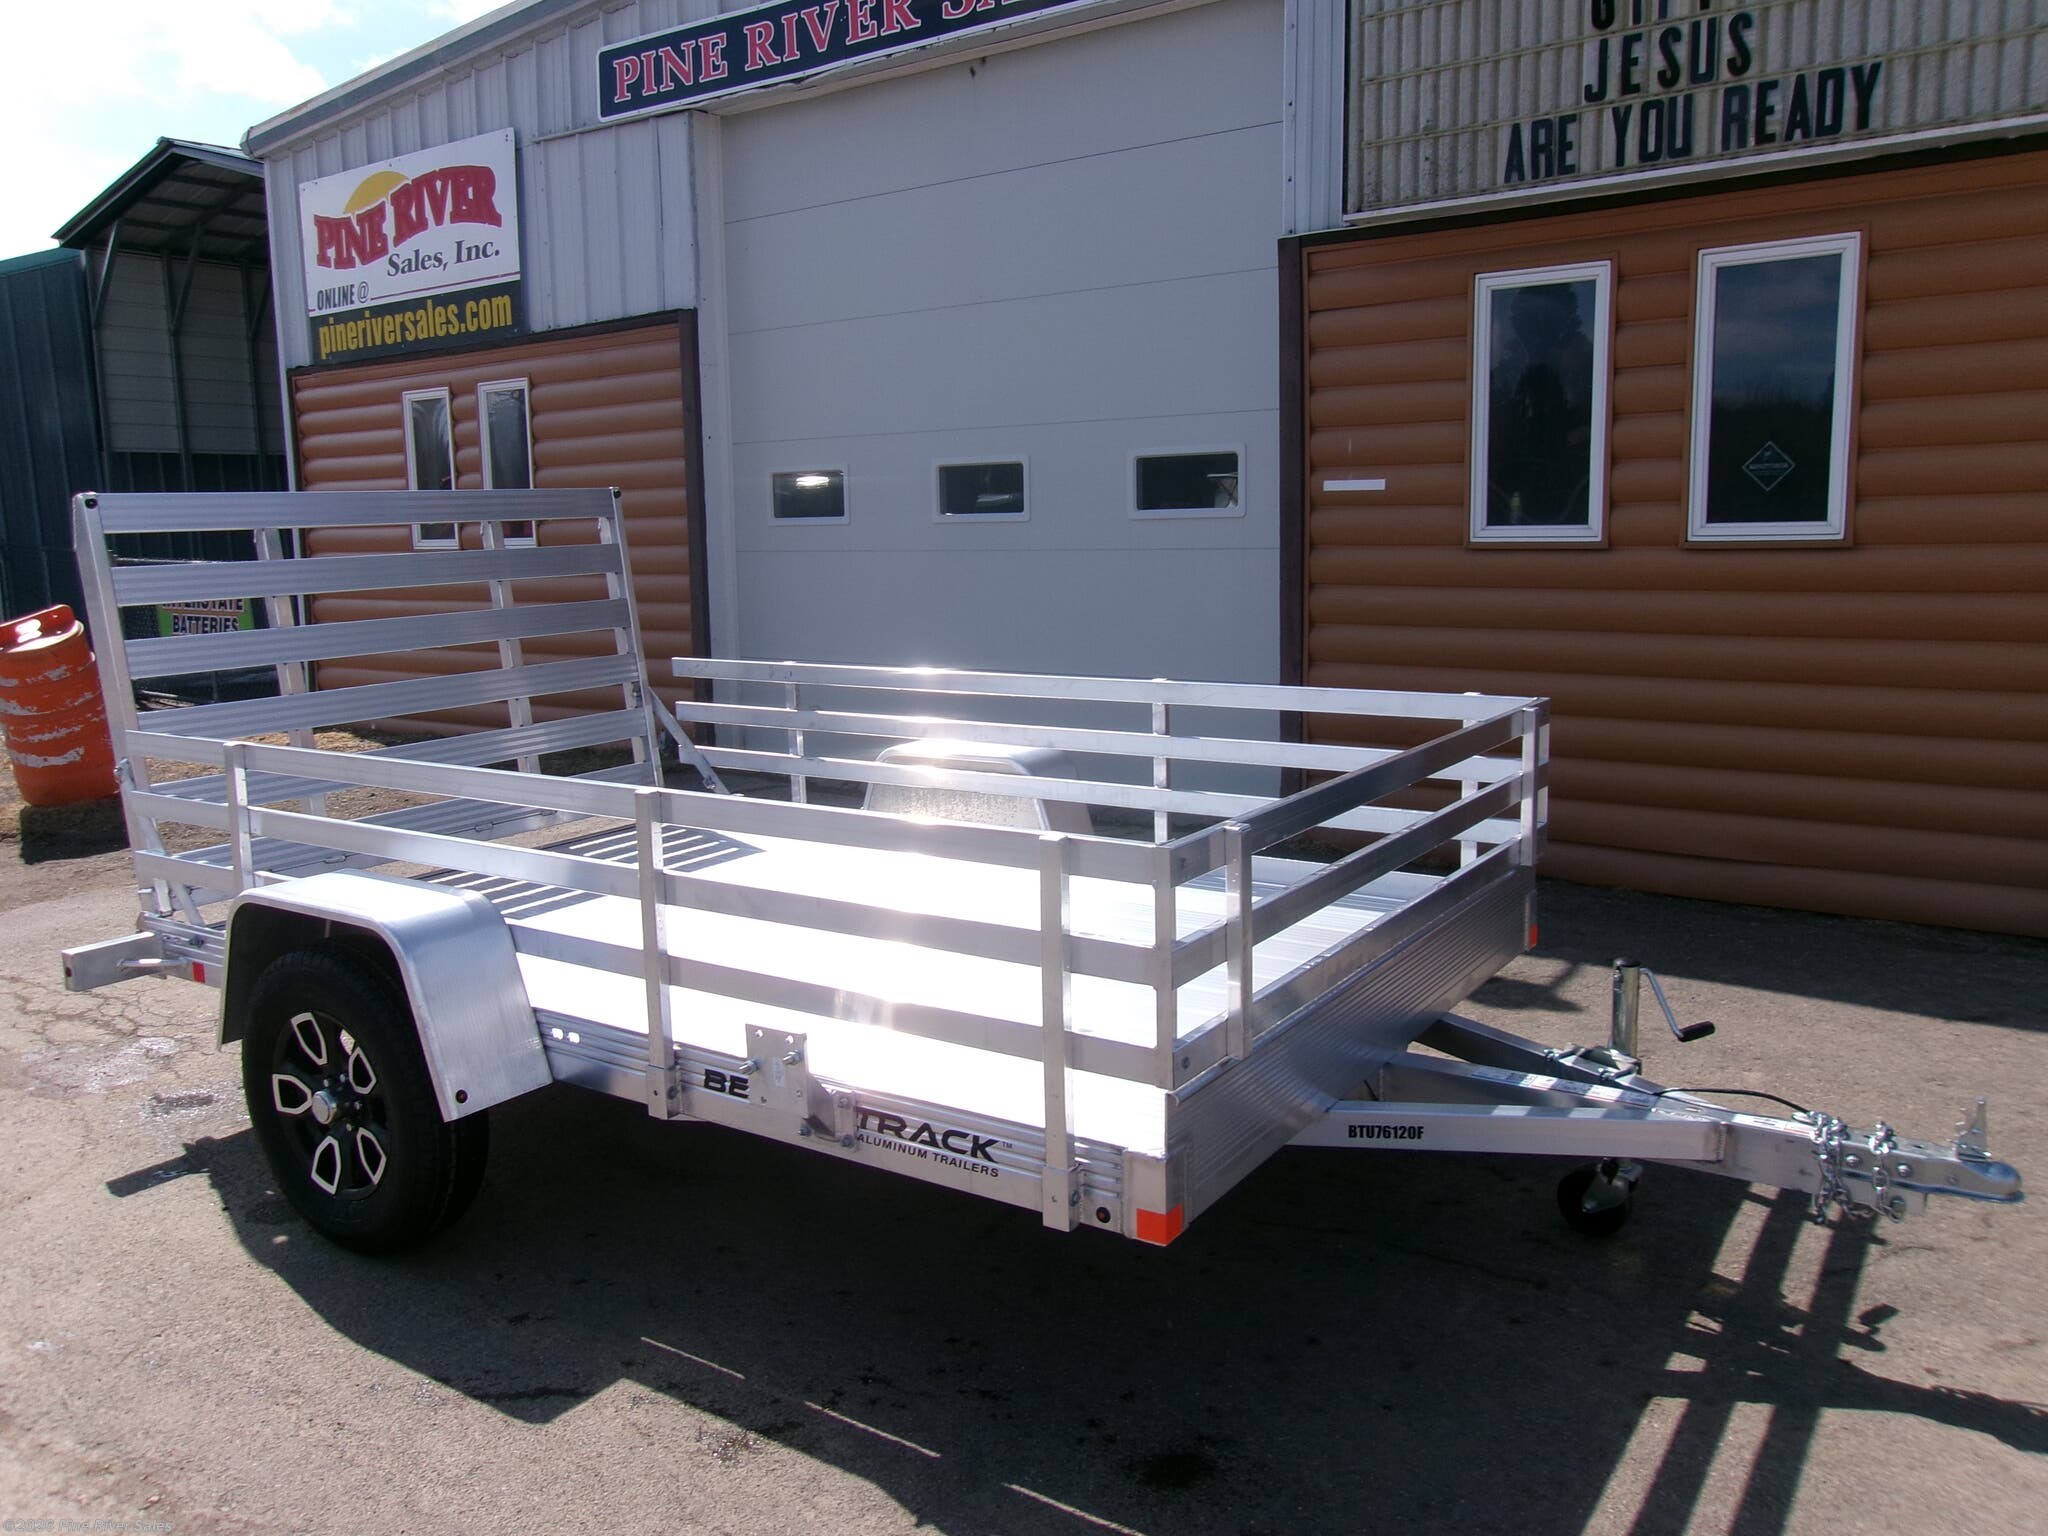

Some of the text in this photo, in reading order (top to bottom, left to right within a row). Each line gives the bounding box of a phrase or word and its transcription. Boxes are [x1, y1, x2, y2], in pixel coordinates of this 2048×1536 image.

[614, 0, 922, 103] PINE RIVER
[1584, 12, 1753, 103] JESUS
[1504, 61, 1884, 184] ARE YOU READY
[313, 165, 502, 270] PINE RIVER
[386, 239, 500, 277] Sales, Inc.
[317, 284, 355, 311] ONLINE
[319, 294, 512, 359] pineriversales.com
[173, 615, 239, 634] BATTERIES
[857, 1132, 1001, 1179] ALUMINUM TRAILERS
[1348, 1124, 1424, 1140] BTU76120F
